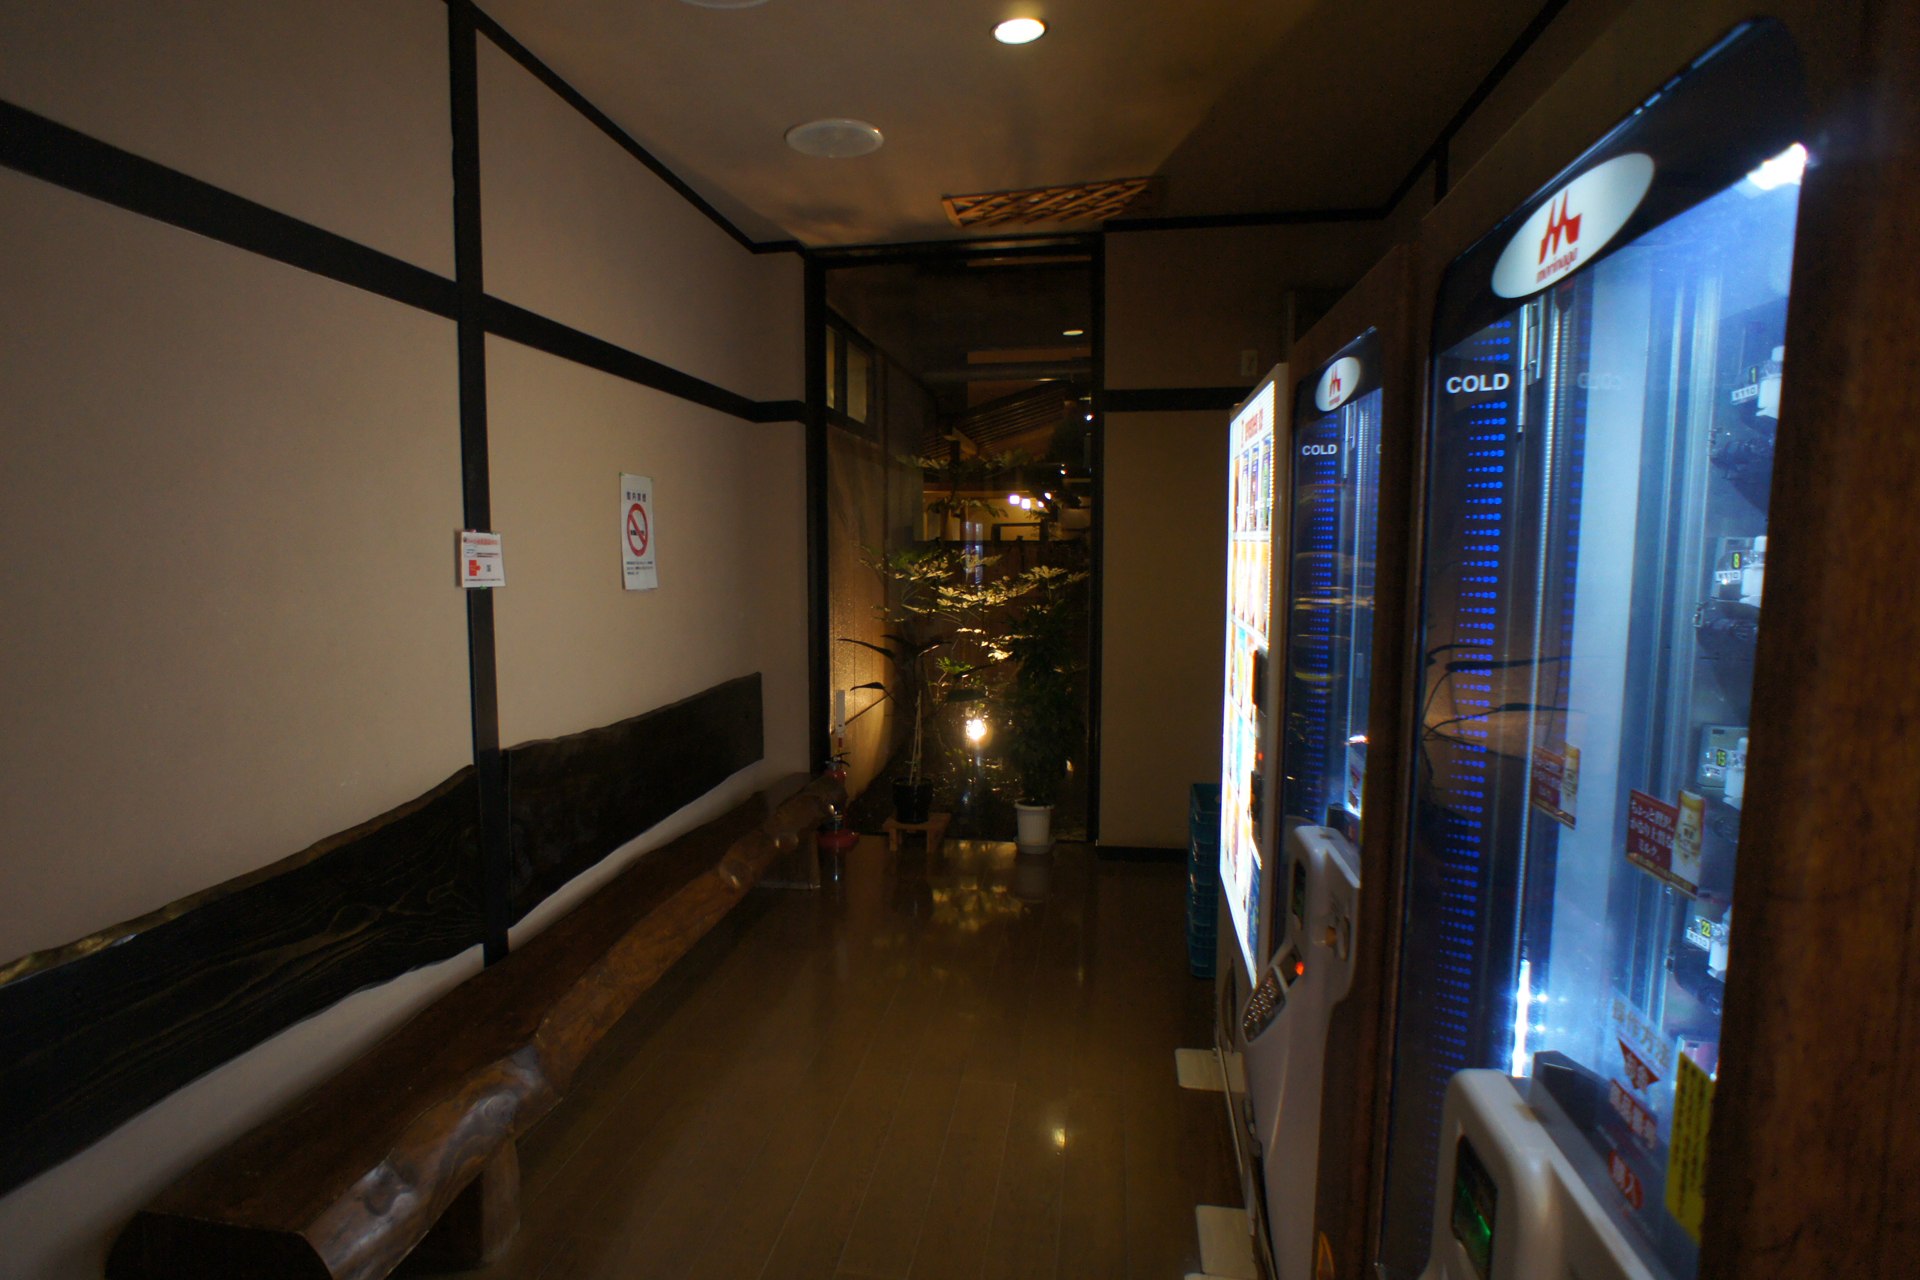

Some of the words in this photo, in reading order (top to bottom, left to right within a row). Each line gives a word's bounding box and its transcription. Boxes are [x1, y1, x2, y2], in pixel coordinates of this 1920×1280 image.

[1536, 247, 1578, 284] morinaga
[1446, 373, 1510, 393] COLD
[1301, 444, 1338, 456] COLD
[1733, 552, 1740, 568] 8
[1717, 750, 1726, 766] 15
[1701, 920, 1710, 937] 22
